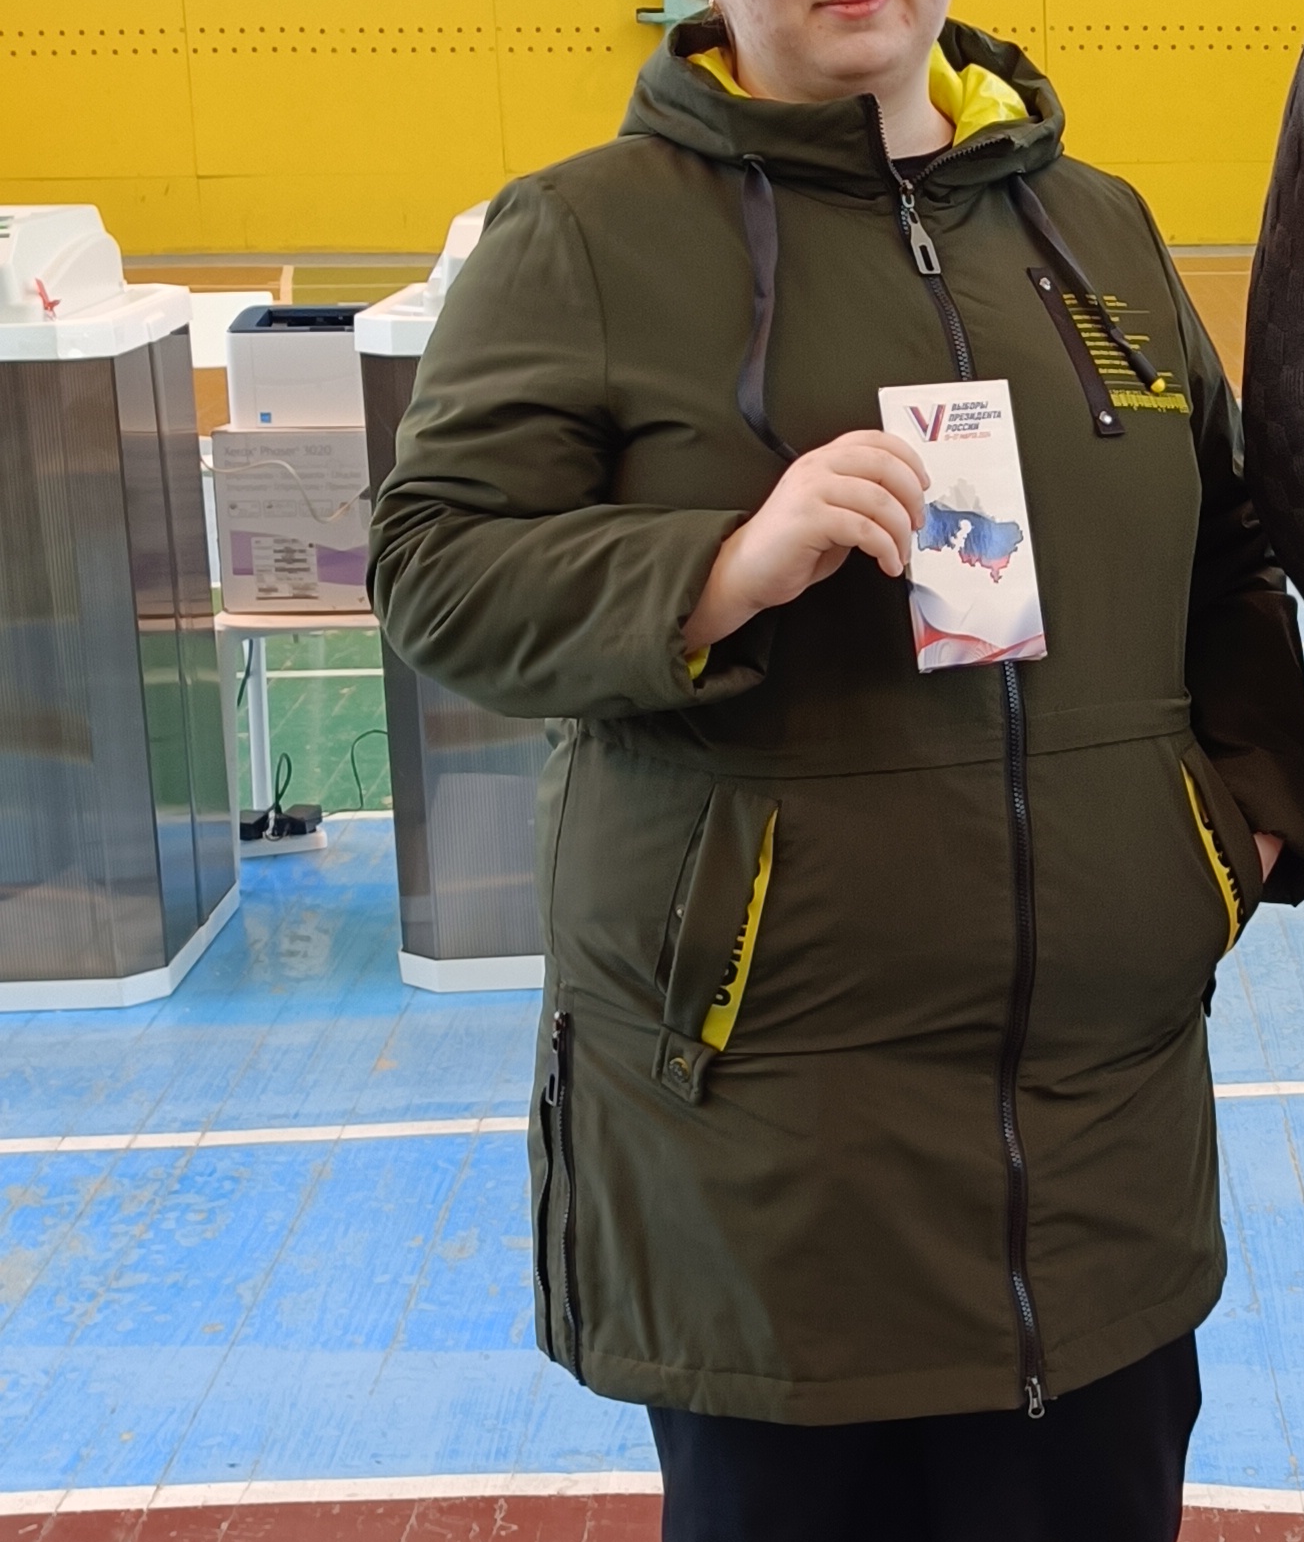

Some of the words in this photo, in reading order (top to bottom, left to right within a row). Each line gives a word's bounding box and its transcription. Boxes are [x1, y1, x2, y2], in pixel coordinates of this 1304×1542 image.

[951, 401, 988, 411] ВЫБОРЫ
[948, 411, 1001, 422] ПРЕЗИДЕНТА
[945, 422, 980, 433] РОССИИ
[304, 444, 332, 456] 3020
